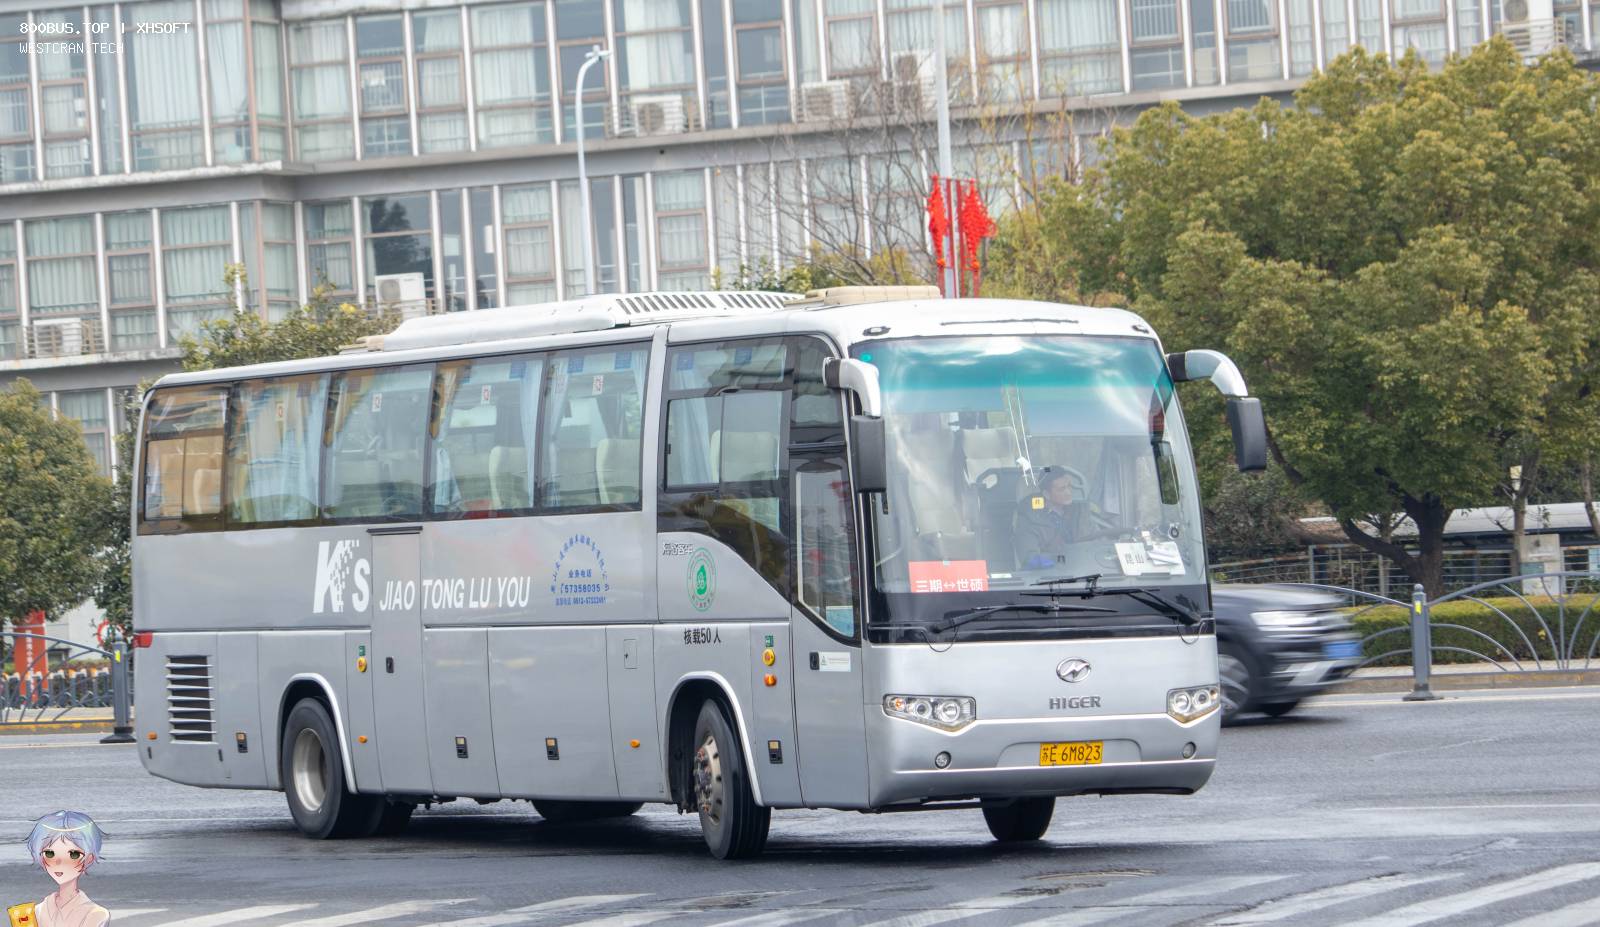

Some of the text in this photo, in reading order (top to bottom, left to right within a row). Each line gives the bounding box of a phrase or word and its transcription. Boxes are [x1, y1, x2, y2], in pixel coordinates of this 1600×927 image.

[379, 576, 531, 611] JIAO TONG LU YOU
[1048, 696, 1102, 710] HIGER
